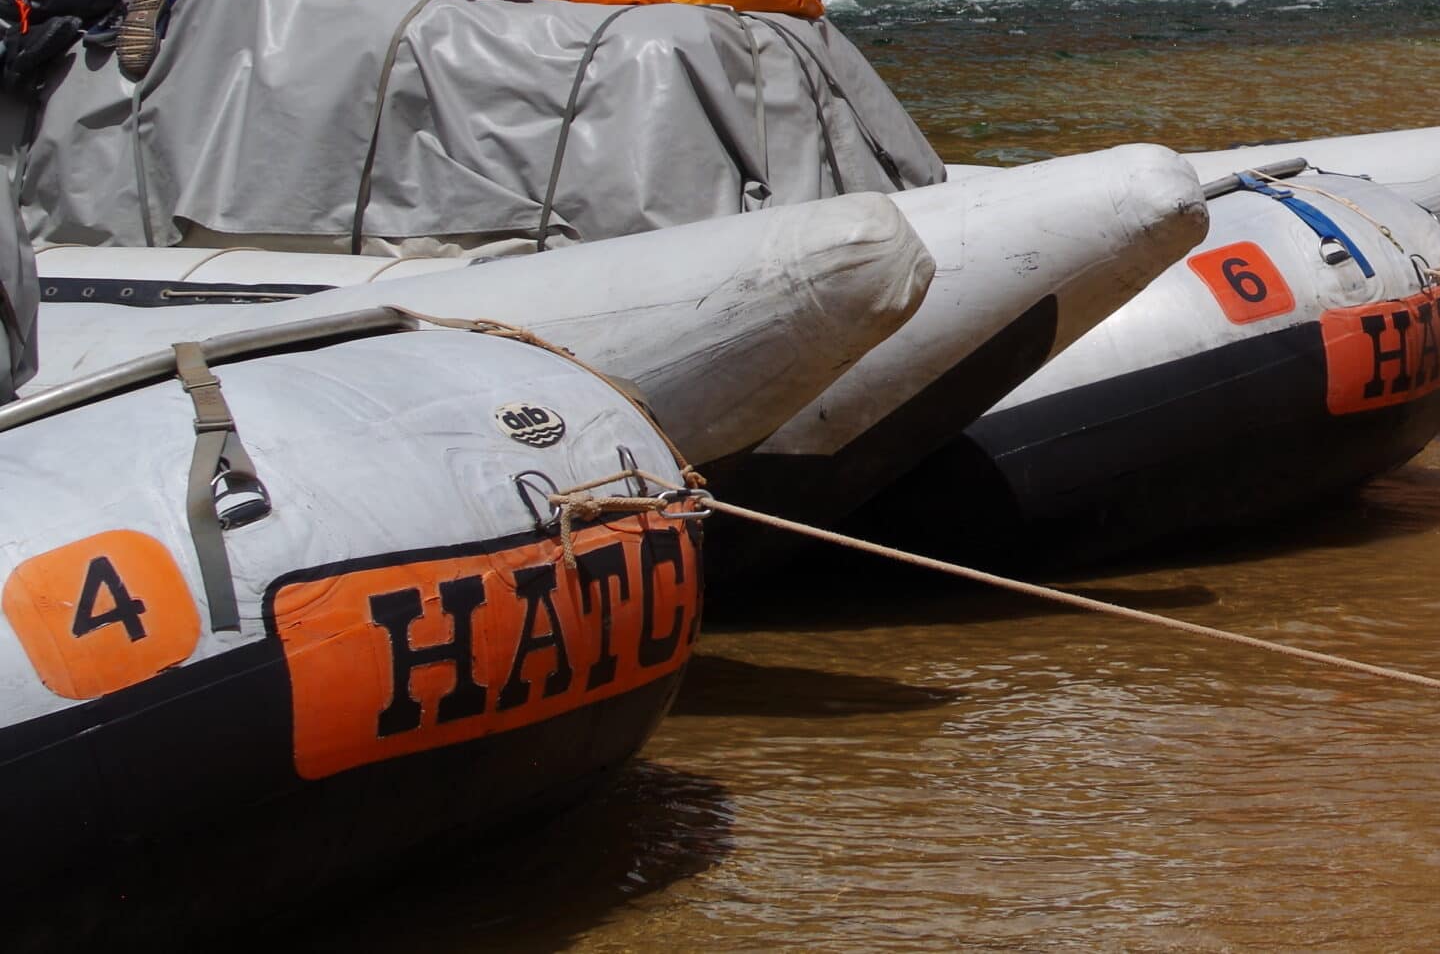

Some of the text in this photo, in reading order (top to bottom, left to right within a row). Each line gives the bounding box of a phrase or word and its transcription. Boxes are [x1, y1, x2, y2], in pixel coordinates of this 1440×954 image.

[1222, 257, 1267, 302] 6
[72, 556, 146, 642] 4
[368, 529, 700, 739] HATC
